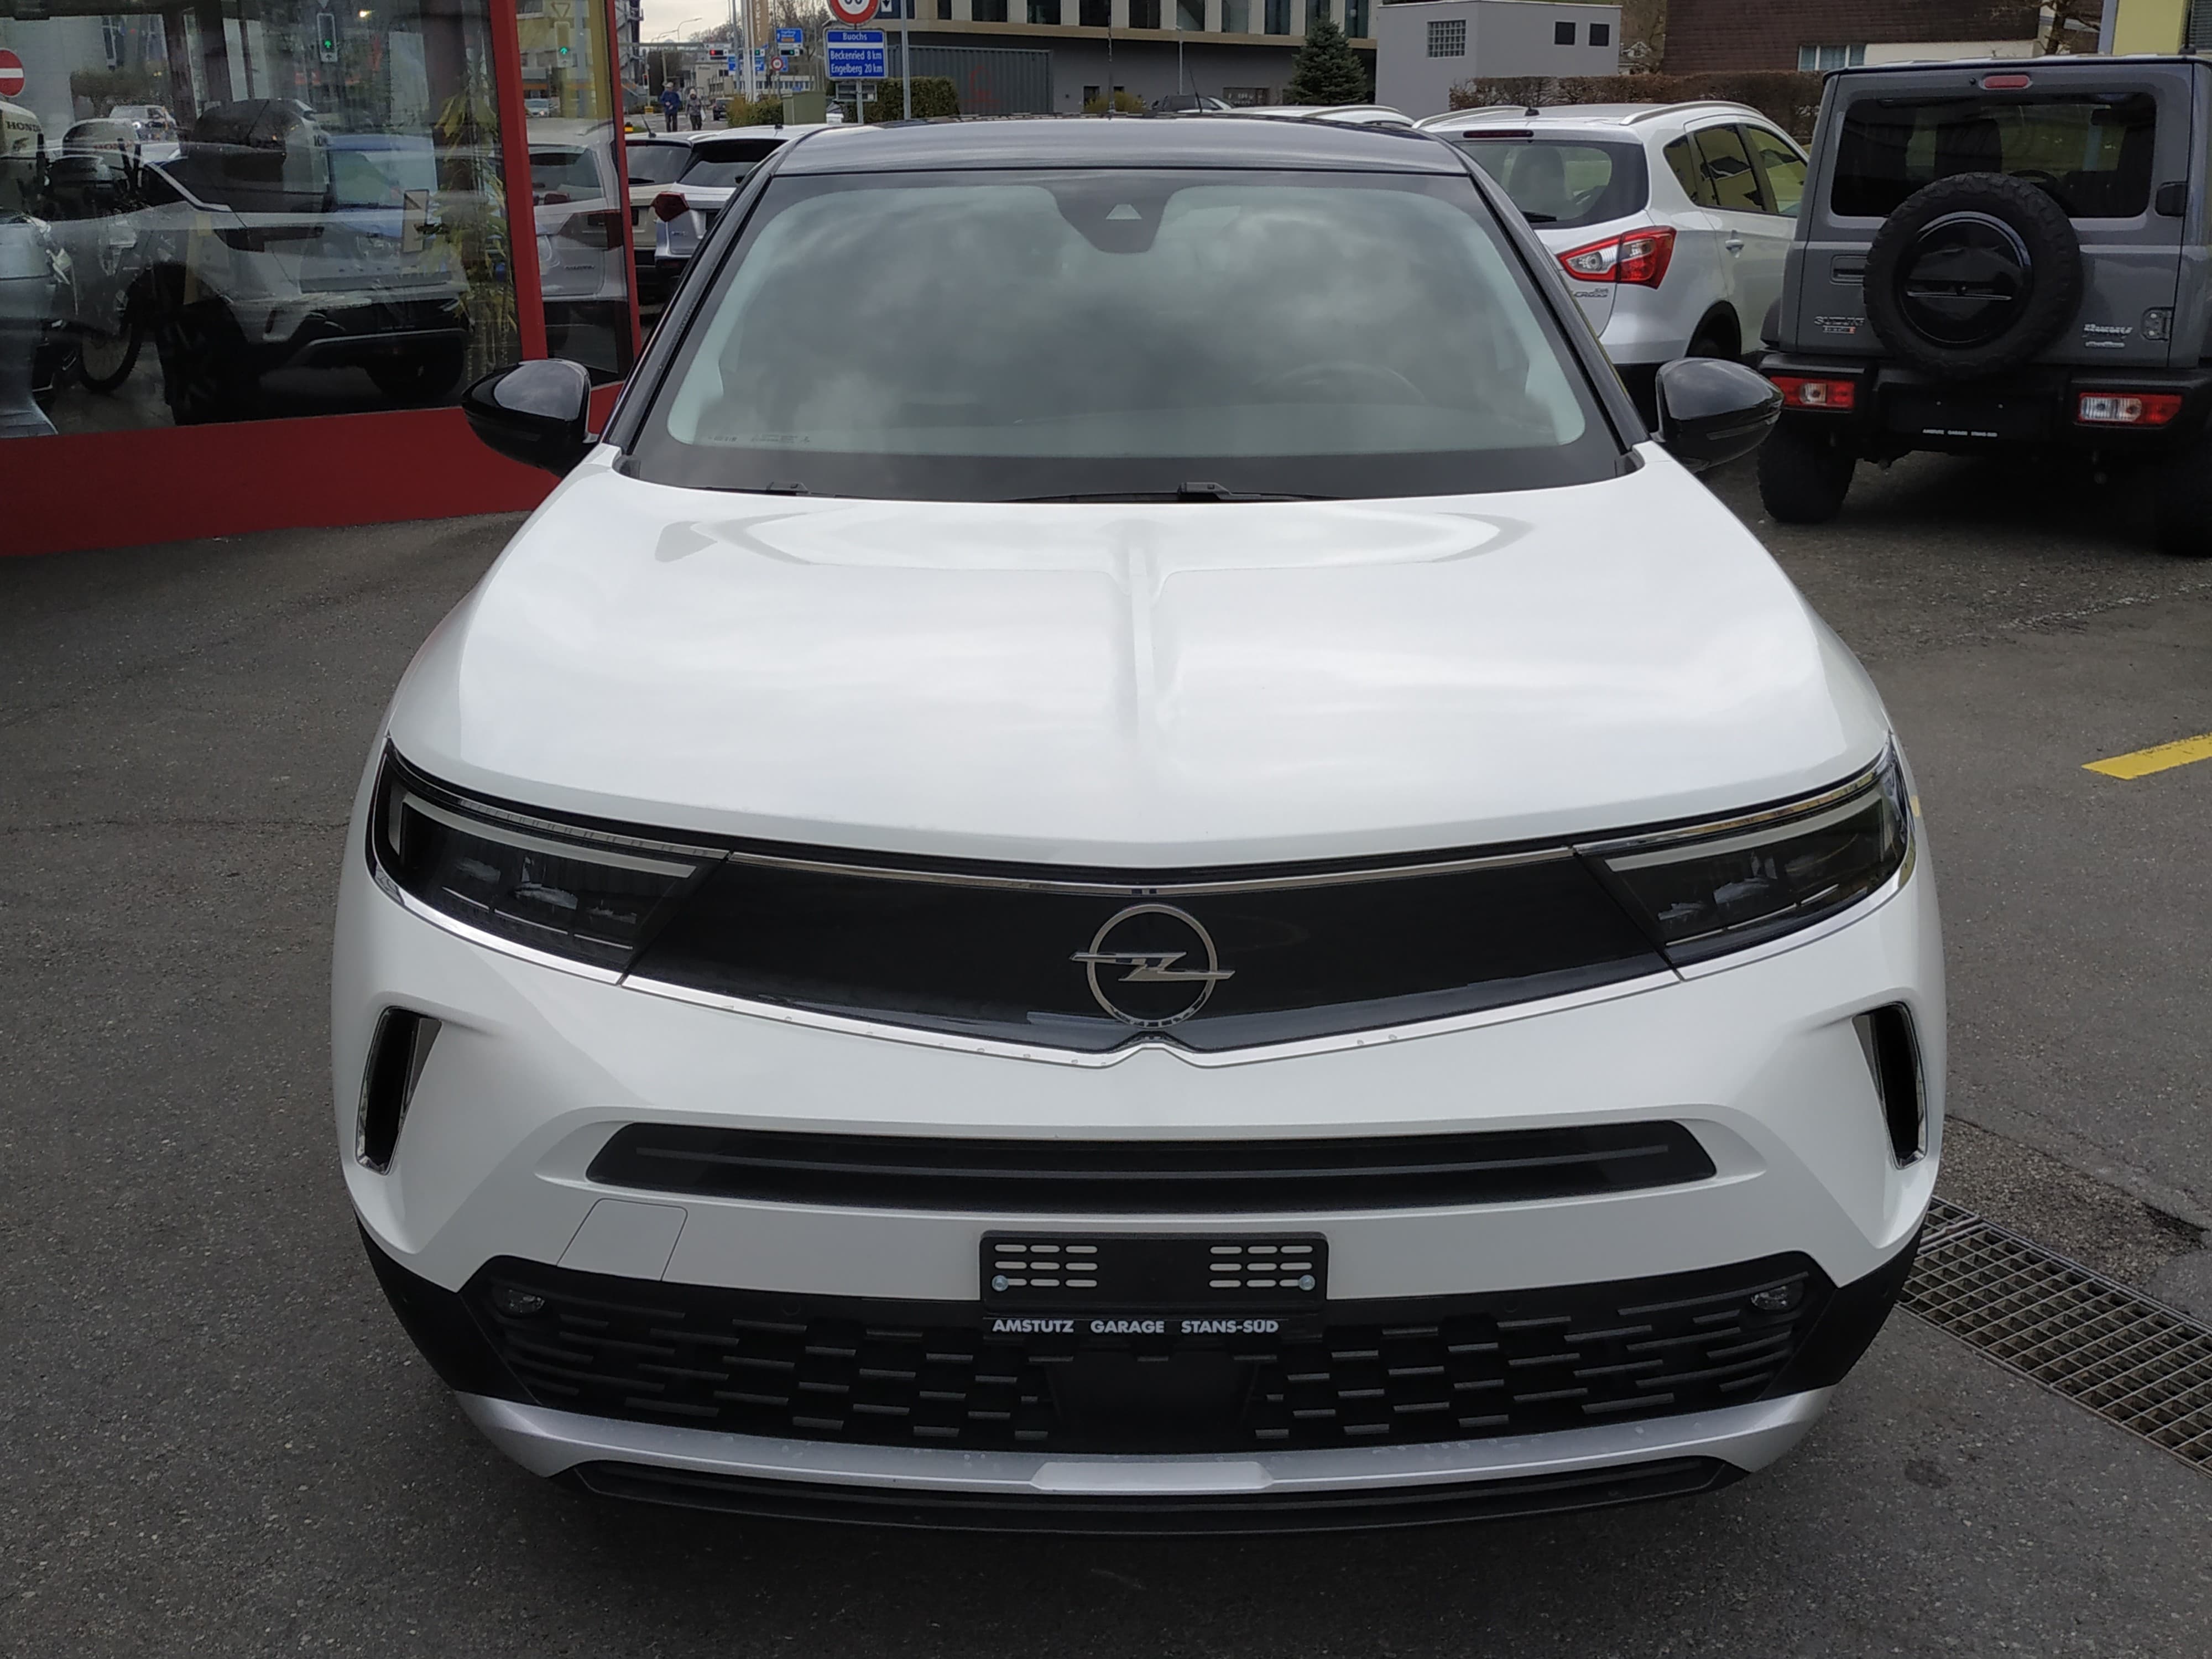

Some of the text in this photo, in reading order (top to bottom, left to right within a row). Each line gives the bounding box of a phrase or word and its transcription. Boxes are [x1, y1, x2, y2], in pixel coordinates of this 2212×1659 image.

[842, 32, 868, 40] Buochs
[830, 50, 882, 60] Beckenried 8 km
[831, 64, 883, 75] Engelberg 20 km
[6, 121, 41, 132] HOND
[992, 1319, 1279, 1333] AMSTUTZ GARAGE STANS-SÜD
